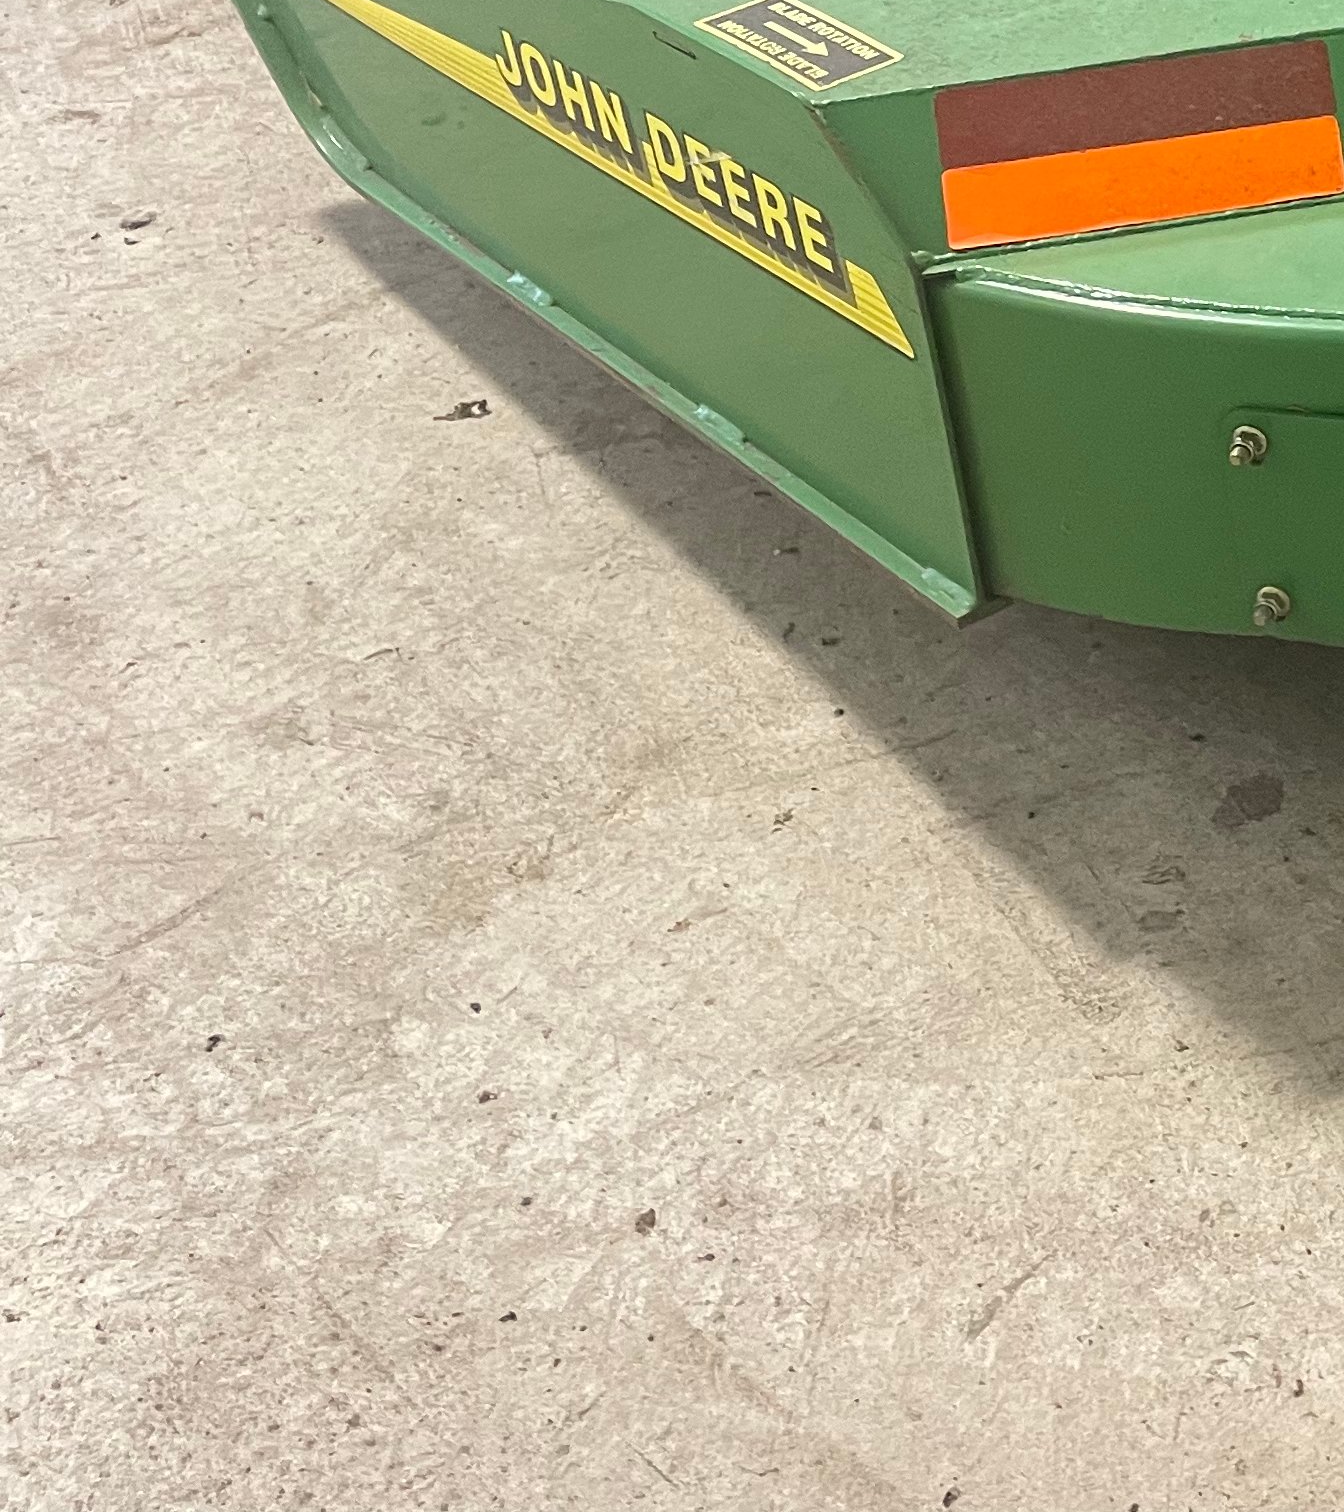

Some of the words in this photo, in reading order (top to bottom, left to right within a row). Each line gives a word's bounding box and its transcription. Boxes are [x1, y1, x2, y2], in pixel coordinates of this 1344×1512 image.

[716, 20, 787, 55] ROTATION
[767, 2, 817, 27] BLADE
[808, 22, 880, 60] ROTATION
[778, 51, 829, 79] BLADE
[495, 29, 634, 155] JOHN
[645, 111, 835, 274] DEERE
